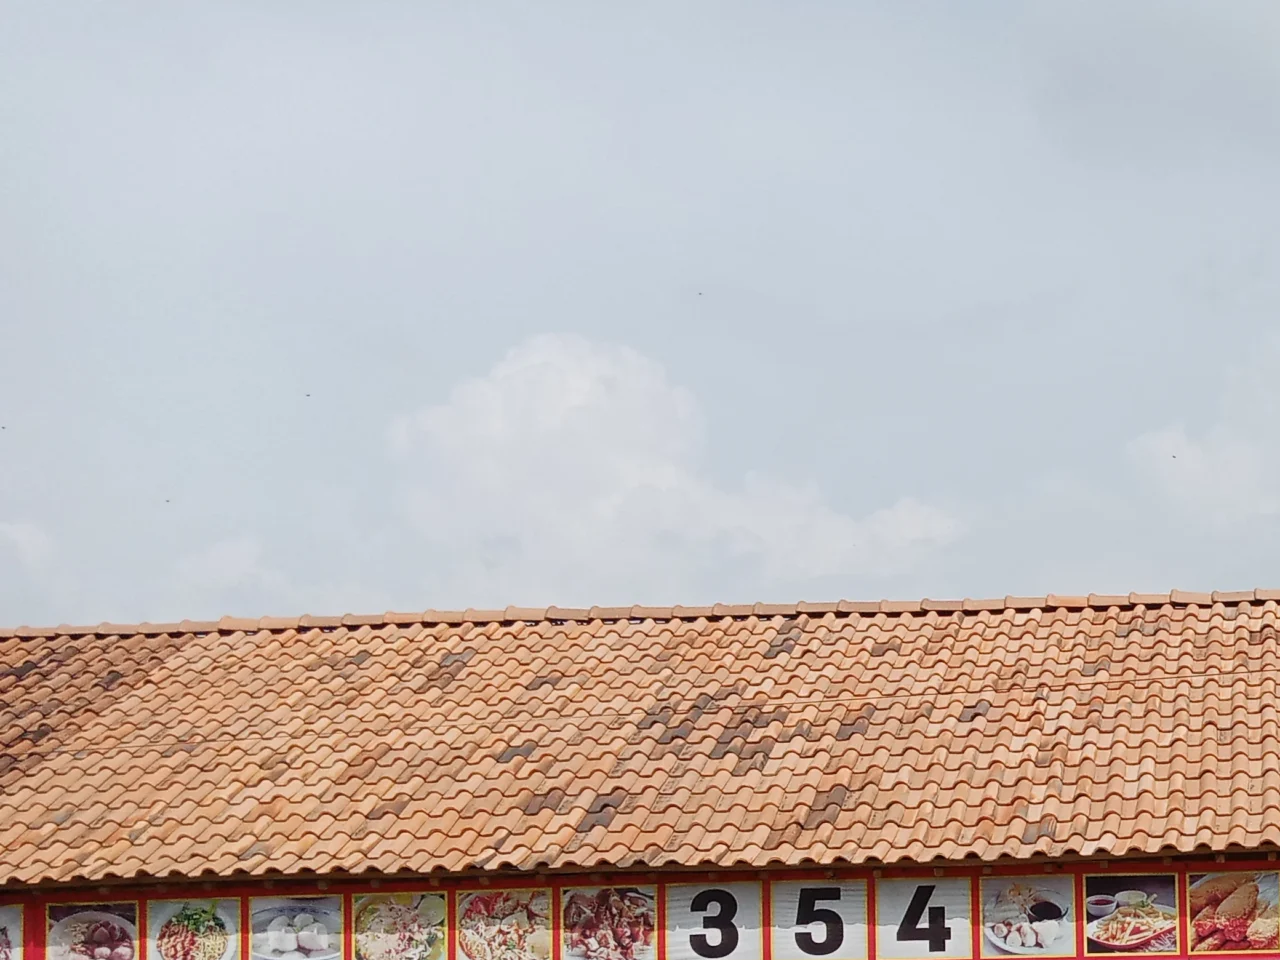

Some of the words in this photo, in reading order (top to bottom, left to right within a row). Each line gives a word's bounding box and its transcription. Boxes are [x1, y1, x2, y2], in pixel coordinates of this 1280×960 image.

[689, 889, 739, 959] 3
[794, 887, 844, 956] 5
[896, 885, 951, 953] 4
